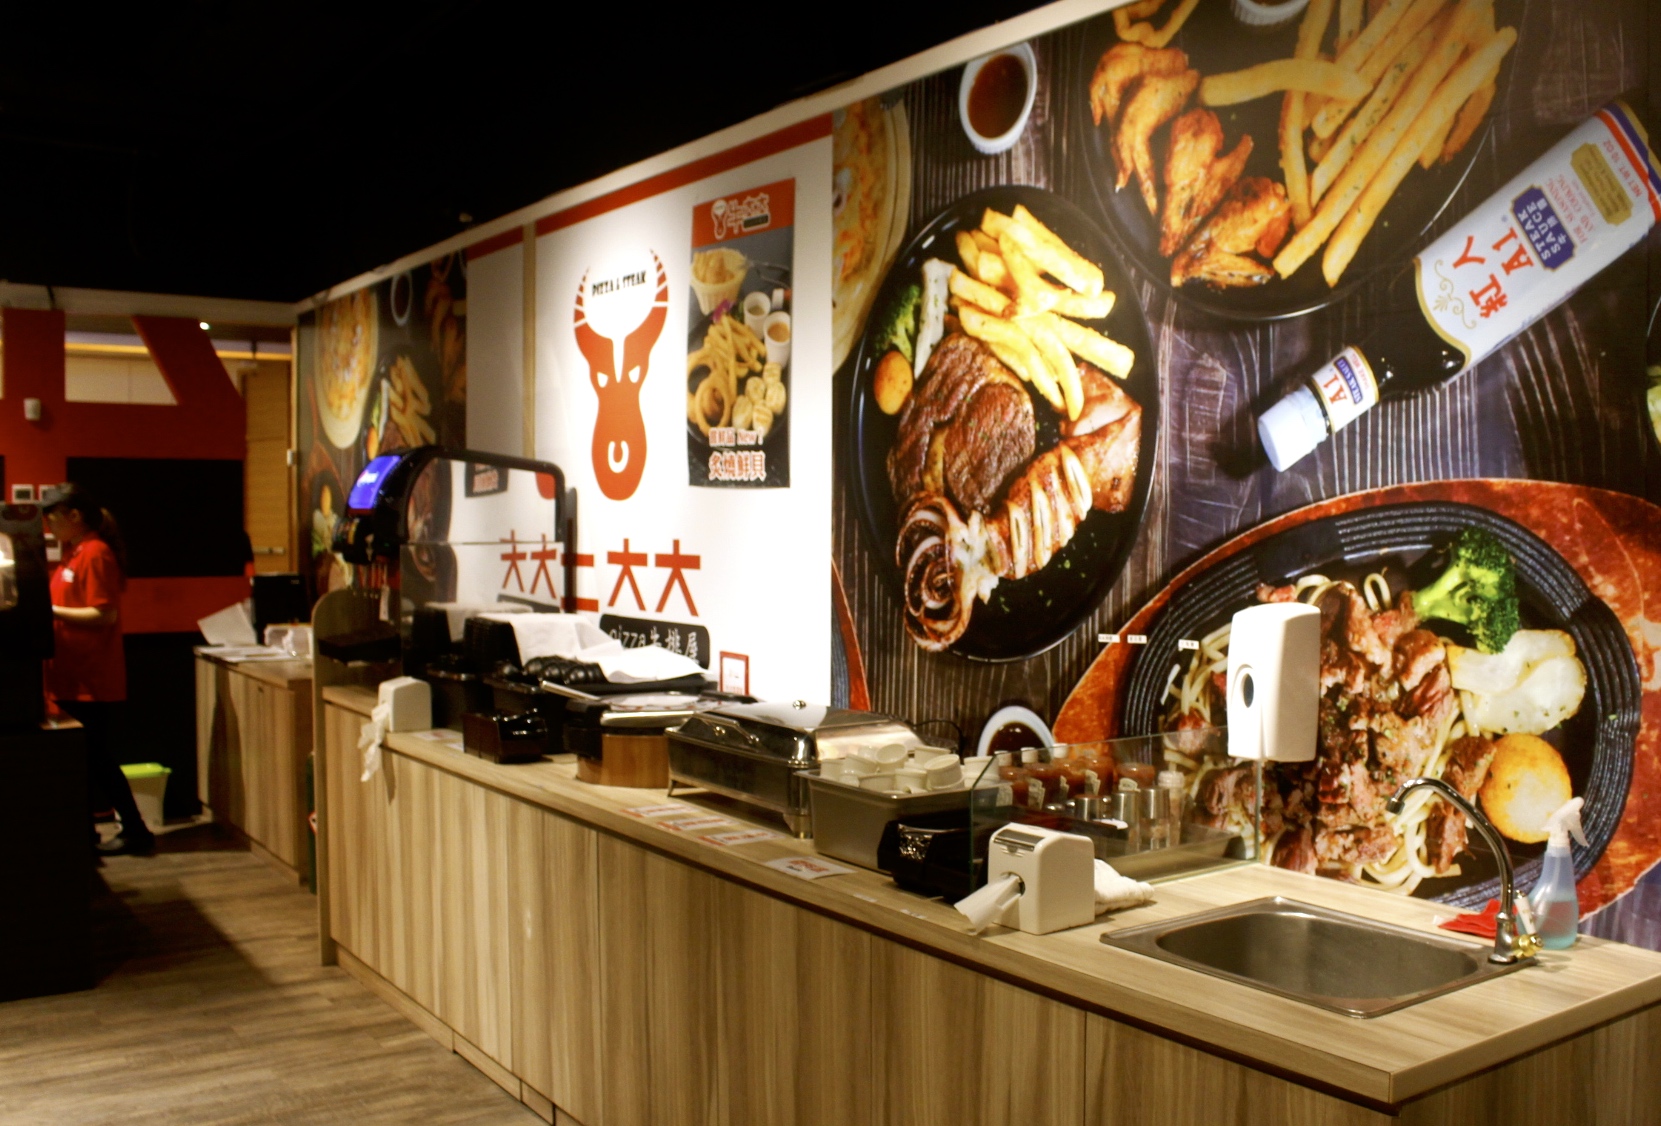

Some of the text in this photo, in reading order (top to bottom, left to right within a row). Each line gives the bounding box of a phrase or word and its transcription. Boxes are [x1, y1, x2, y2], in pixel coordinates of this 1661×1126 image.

[1492, 227, 1534, 276] A1
[1516, 209, 1552, 261] STEAK
[1526, 202, 1562, 254] SAUCE
[1453, 235, 1511, 319] 紅人
[1324, 376, 1347, 403] A1
